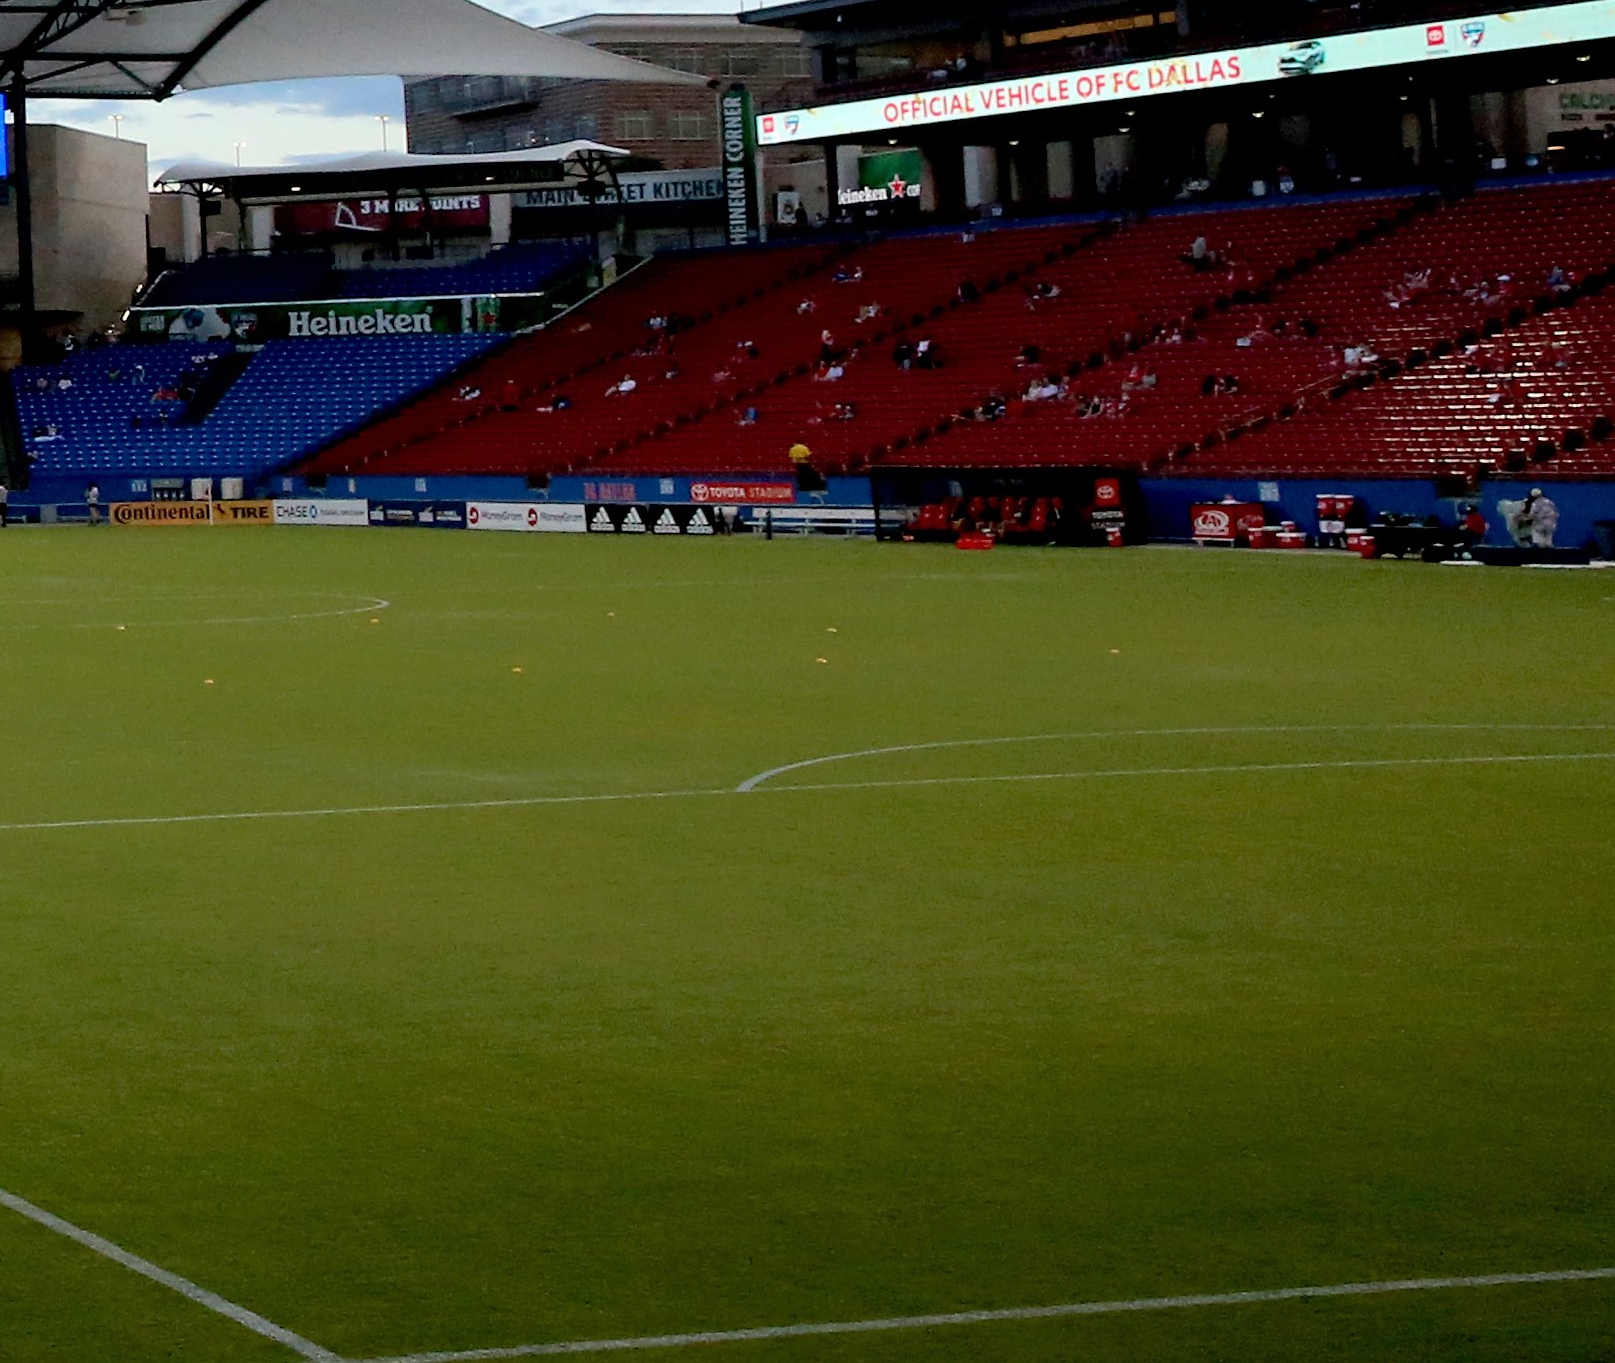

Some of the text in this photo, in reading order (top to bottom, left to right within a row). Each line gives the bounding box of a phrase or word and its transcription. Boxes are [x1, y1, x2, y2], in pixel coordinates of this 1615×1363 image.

[884, 56, 1241, 123] OFFICIAL VEHICLE OF FC DALLAS
[723, 97, 747, 245] HEINEKEN CORNER
[288, 310, 434, 337] Heineken
[709, 487, 746, 498] TOYOTA
[114, 501, 269, 522] Continental TIRE
[277, 505, 309, 518] CHASE
